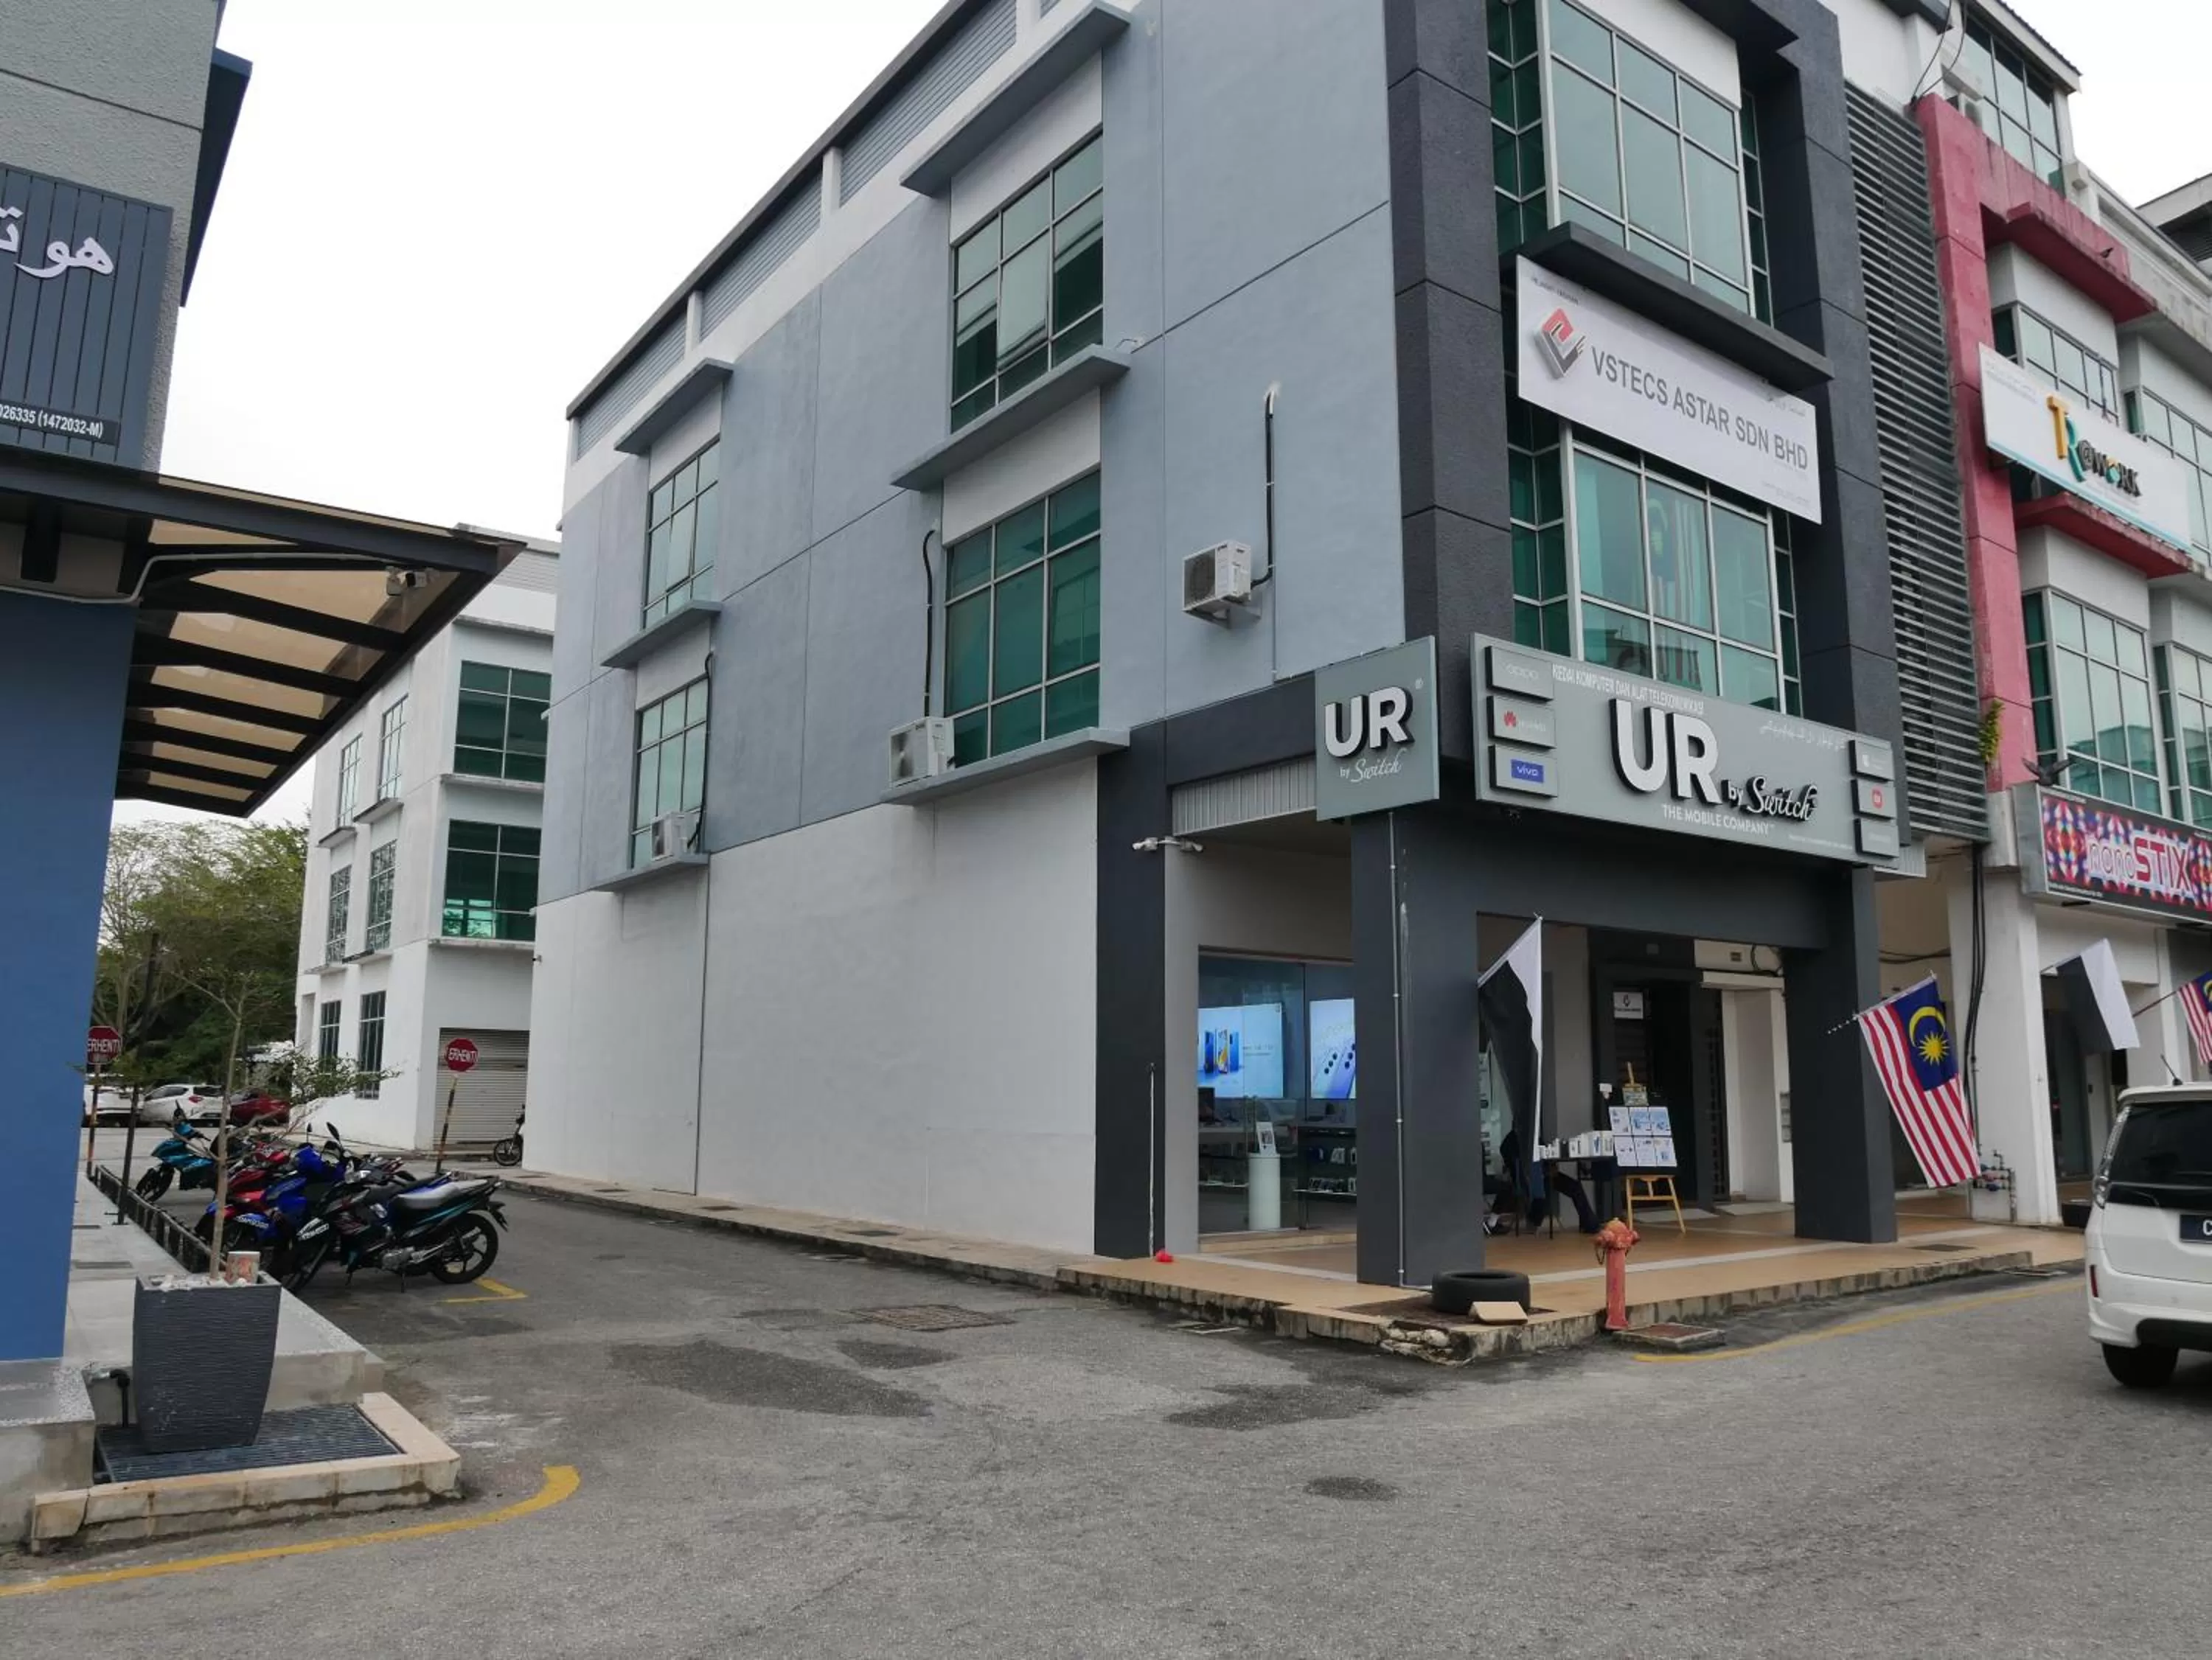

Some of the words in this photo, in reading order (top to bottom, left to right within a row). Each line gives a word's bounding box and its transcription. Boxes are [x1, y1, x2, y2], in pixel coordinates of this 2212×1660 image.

[38, 410, 103, 439] (1472032-M)
[1591, 345, 1668, 406] VSTECS
[1673, 386, 1731, 436] ASTAR
[1736, 415, 1769, 454] SDN
[1773, 433, 1808, 470] BHD
[1552, 663, 1576, 685] KEDAI
[1576, 669, 1615, 693] KOMPUTER
[1615, 680, 1630, 697] DAN
[1324, 686, 1413, 758] UR
[1350, 747, 1408, 784] Switch
[1516, 764, 1540, 777] vivo
[1610, 697, 1722, 806] UR
[1728, 779, 1745, 807] by
[1746, 775, 1818, 821] Switch
[1662, 803, 1683, 822] THE
[1684, 810, 1722, 827] MOBILE
[1722, 815, 1769, 836] COMPANY
[86, 1038, 123, 1054] ERHENTI
